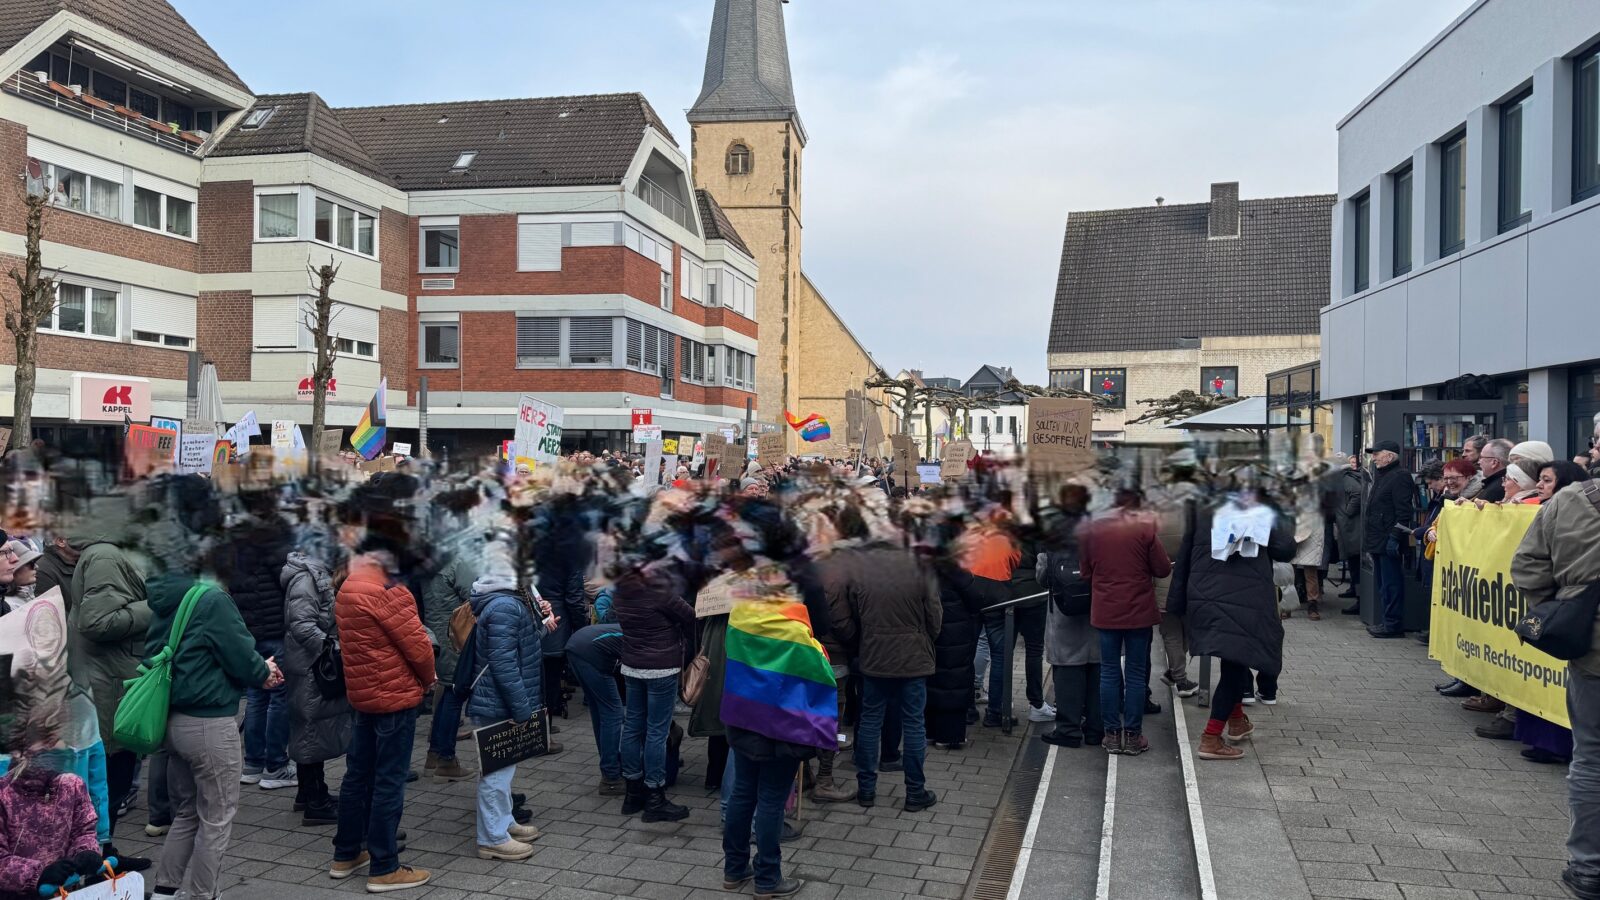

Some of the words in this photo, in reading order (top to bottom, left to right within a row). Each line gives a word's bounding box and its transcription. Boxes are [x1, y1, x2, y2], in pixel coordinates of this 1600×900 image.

[102, 405, 132, 413] KAPPEL
[520, 403, 547, 428] HERZ
[538, 436, 561, 455] MERZ
[1033, 432, 1087, 449] BESOFFENE!
[1457, 632, 1480, 659] Gegen
[1484, 644, 1568, 688] Rechtspopul
